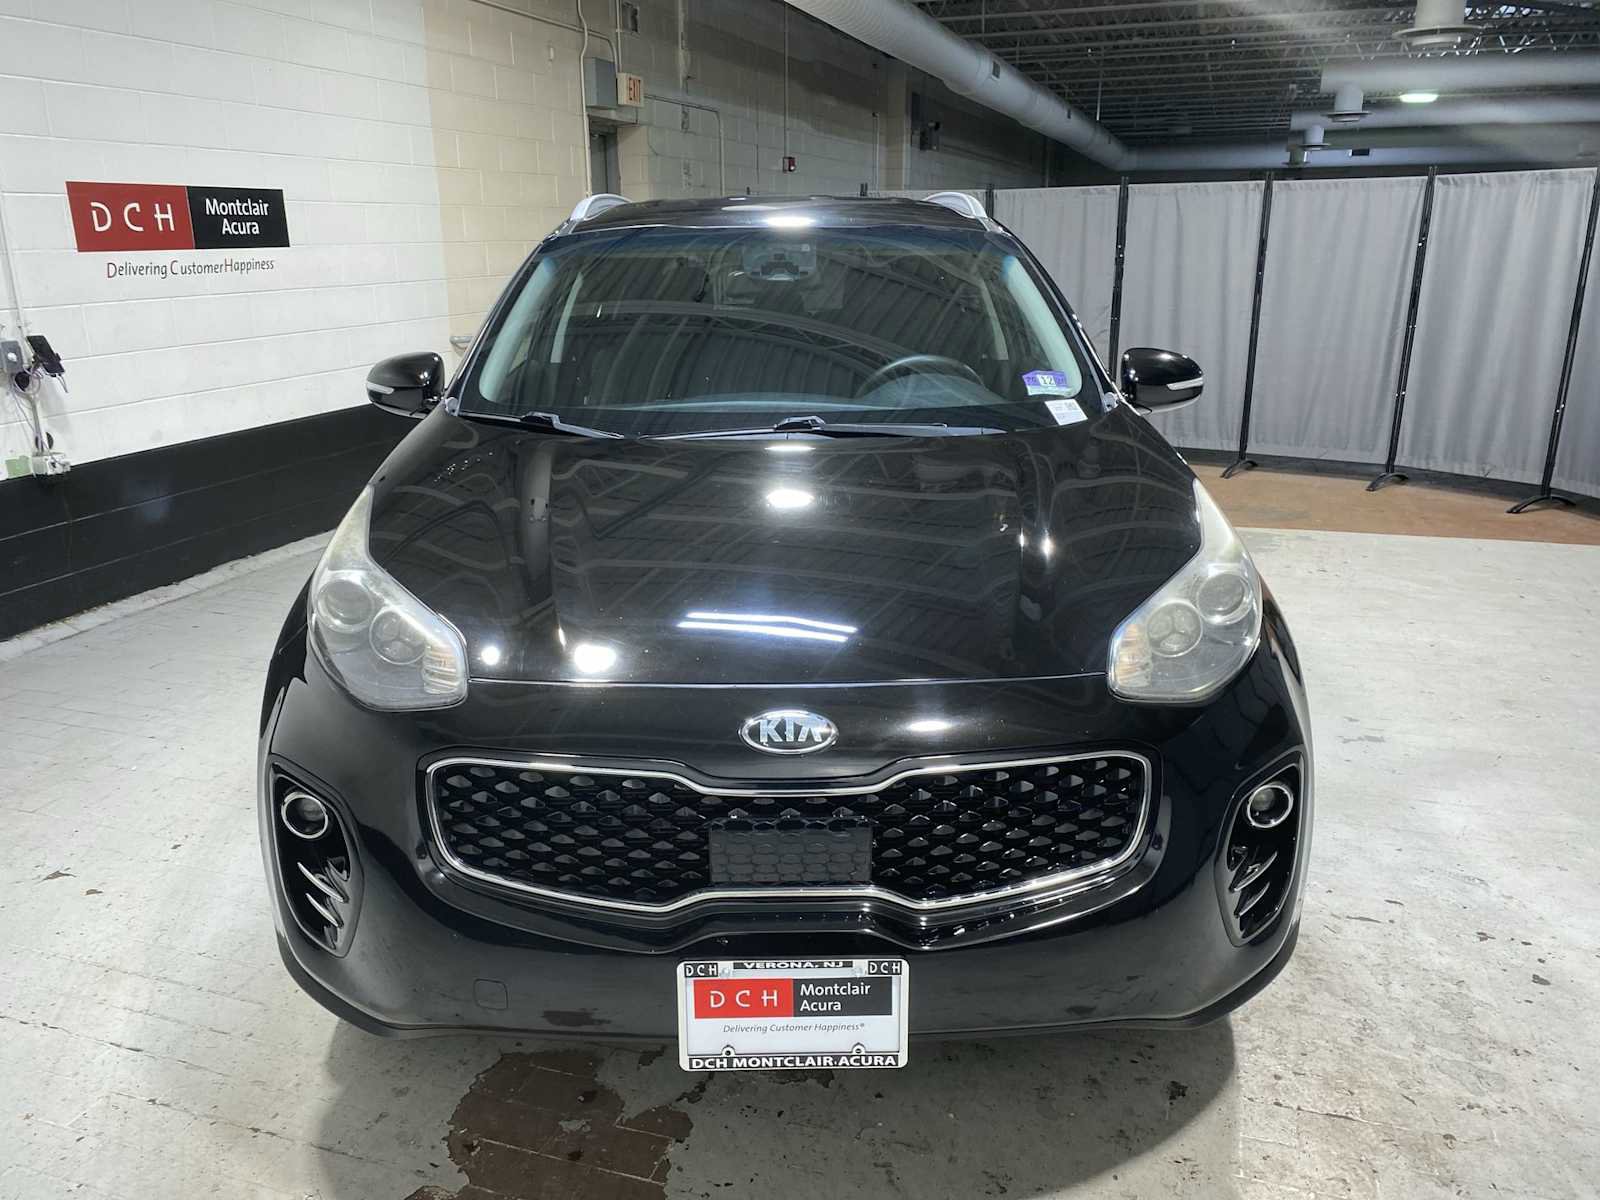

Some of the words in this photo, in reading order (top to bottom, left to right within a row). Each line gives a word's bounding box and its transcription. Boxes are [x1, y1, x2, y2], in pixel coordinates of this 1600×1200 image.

[205, 198, 270, 217] Montclair
[90, 201, 175, 232] DCH
[222, 218, 260, 235] Acura
[106, 262, 168, 279] Delivering
[170, 260, 224, 276] Customer
[224, 257, 275, 274] Happiness
[758, 716, 823, 742] KIA
[685, 964, 718, 977] DCH
[823, 960, 843, 969] NJ
[869, 961, 901, 974] DCH
[800, 982, 871, 997] Montclair
[709, 990, 778, 1008] DCH
[800, 999, 842, 1012] Acura
[723, 1024, 768, 1034] Delivering
[769, 1023, 812, 1032] Customer
[691, 1058, 728, 1069] DCH
[838, 1055, 897, 1067] ACURA
